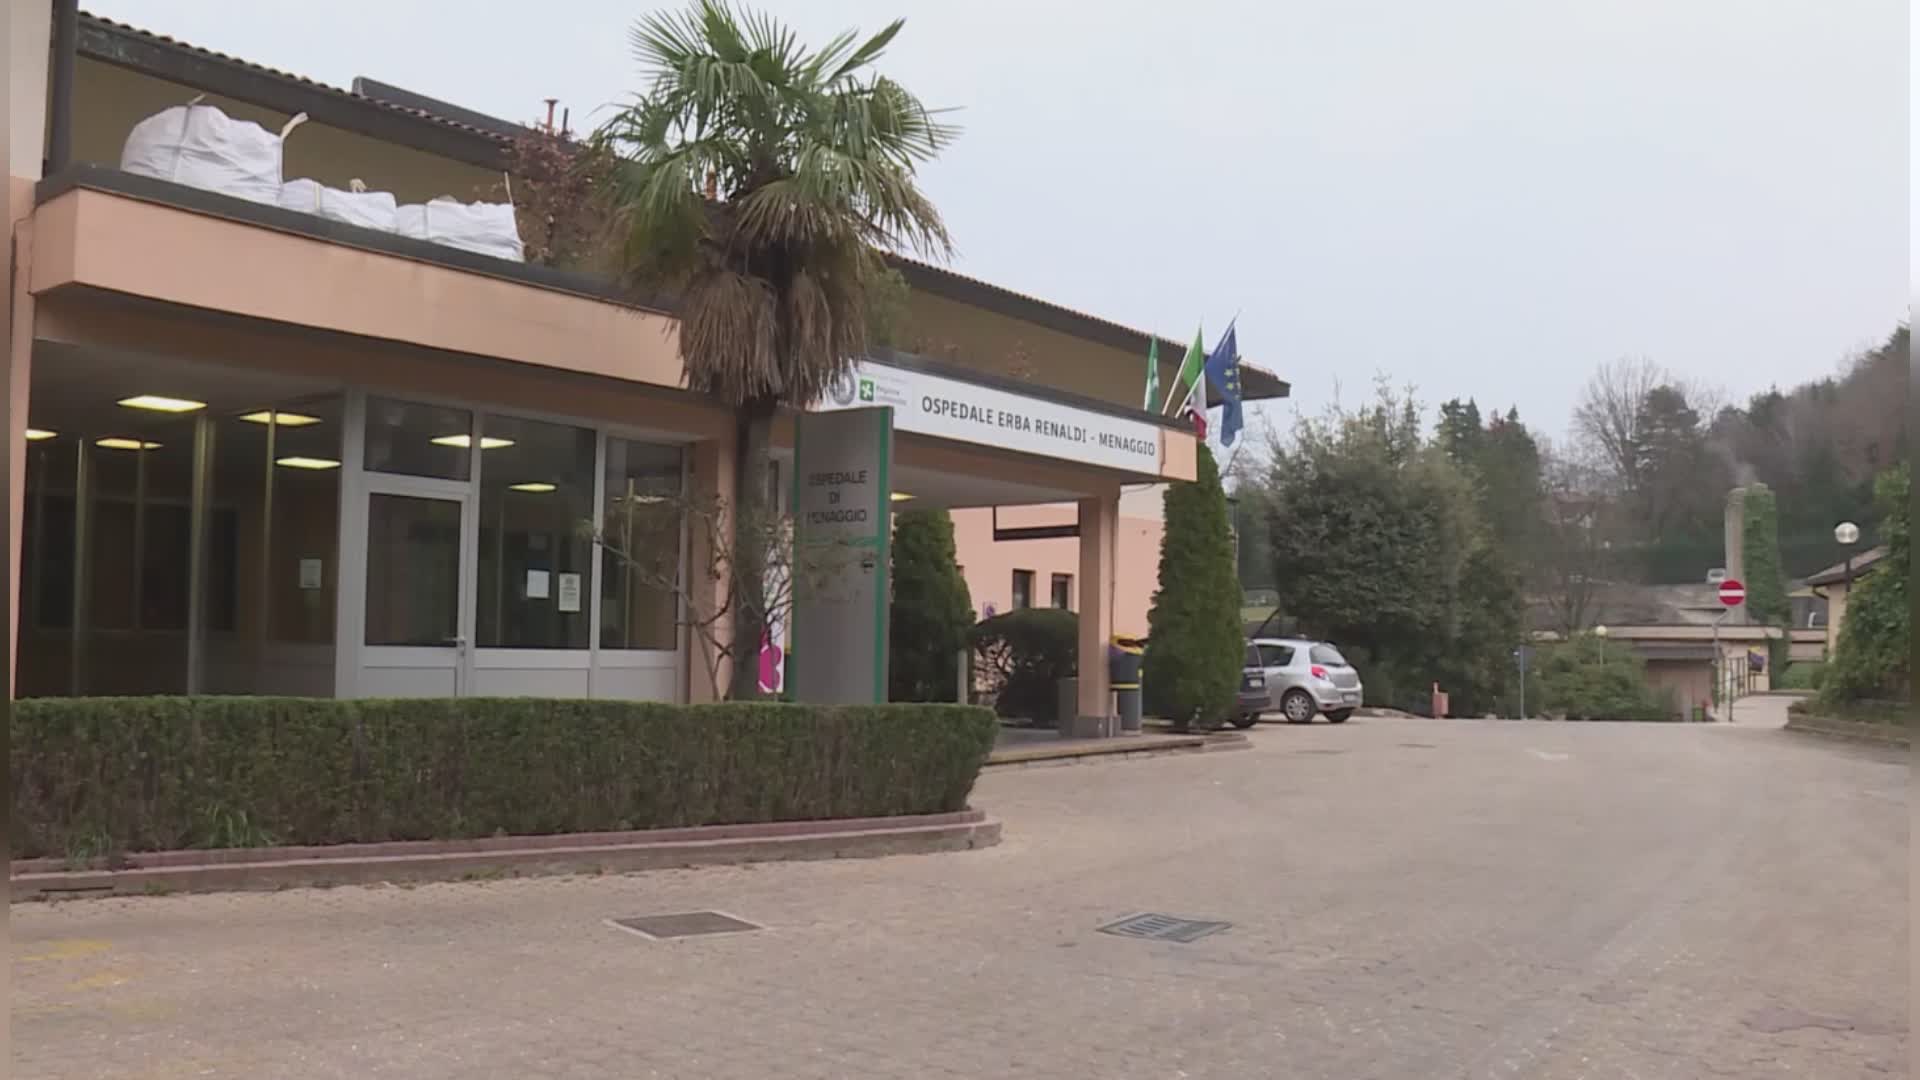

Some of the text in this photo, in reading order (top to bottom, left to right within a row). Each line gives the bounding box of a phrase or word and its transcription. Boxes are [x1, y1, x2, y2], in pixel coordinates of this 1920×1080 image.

[921, 396, 994, 424] OSPEDALE
[997, 411, 1031, 432] ERBA
[1035, 419, 1087, 443] RENALDI
[1098, 432, 1156, 457] MENAGGIO
